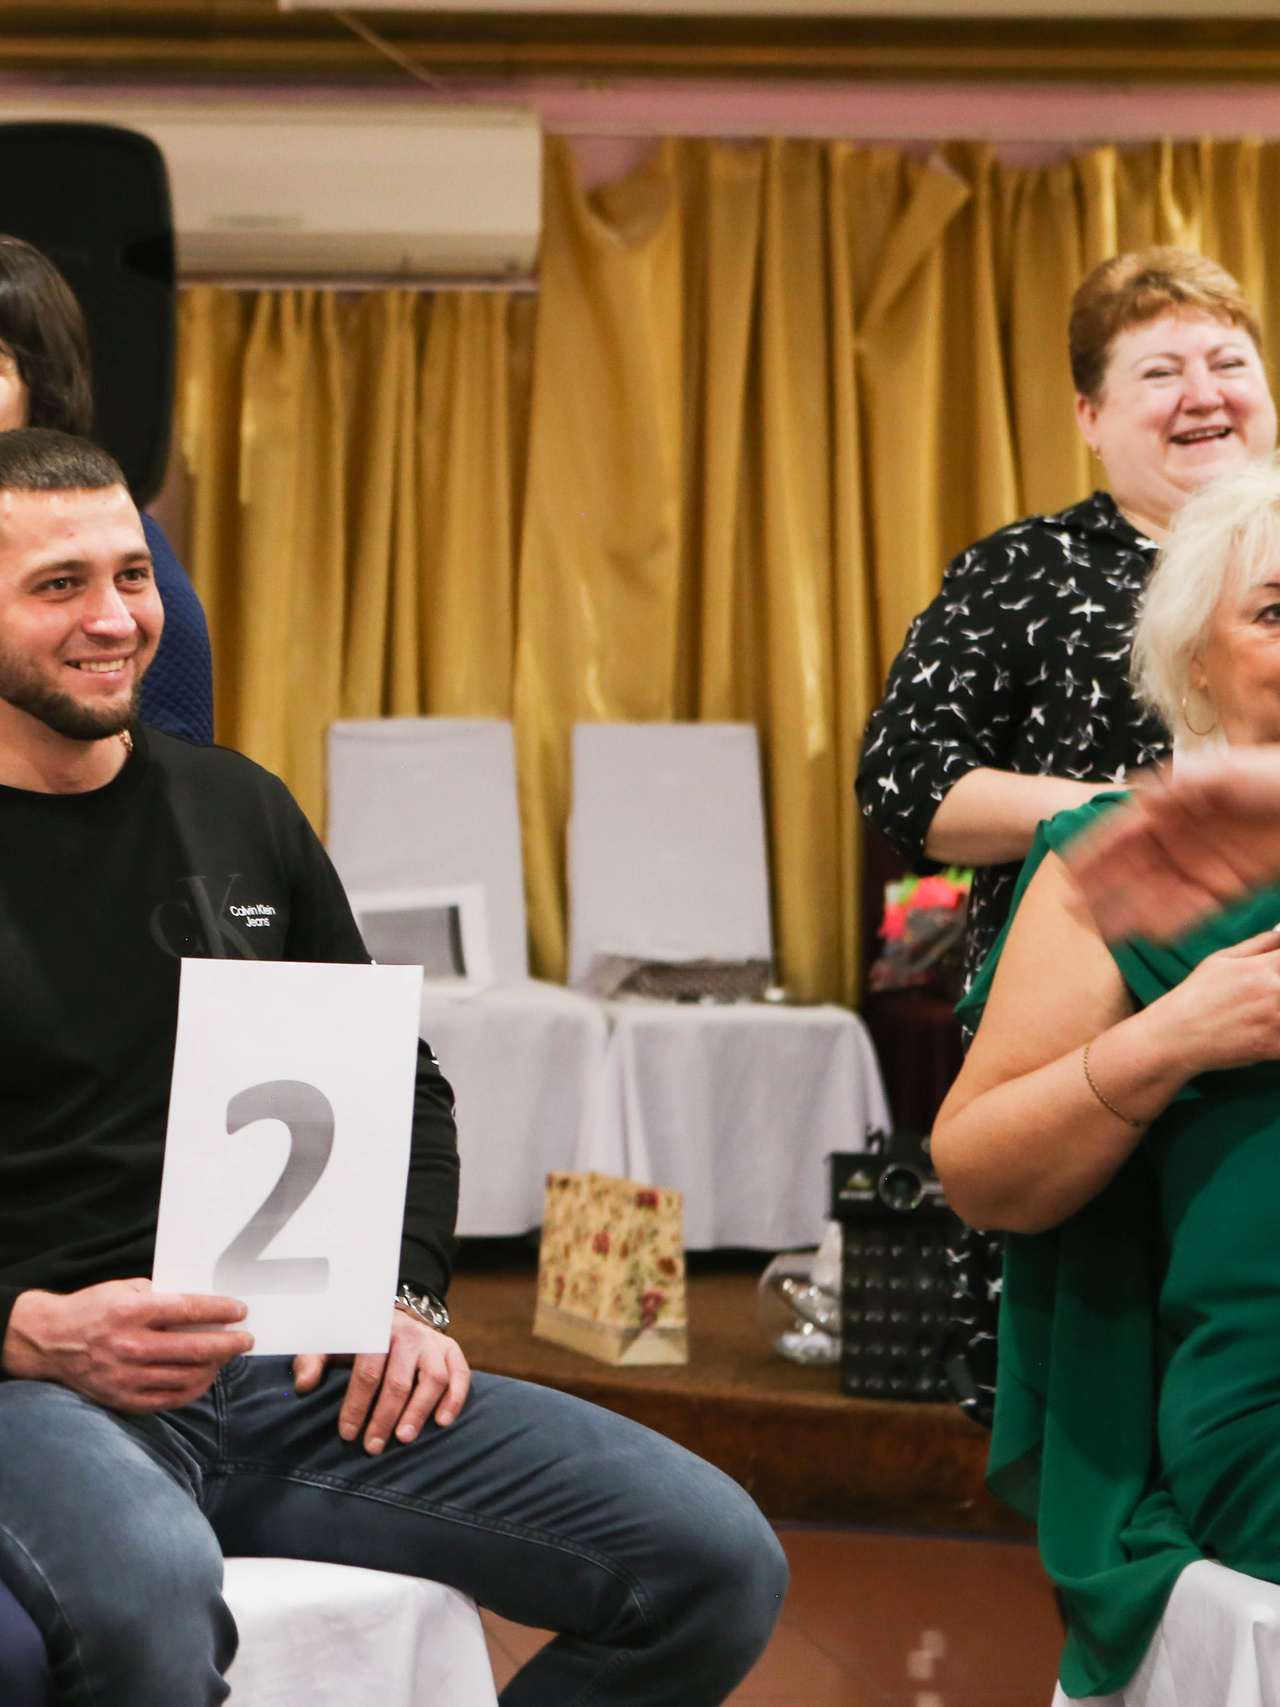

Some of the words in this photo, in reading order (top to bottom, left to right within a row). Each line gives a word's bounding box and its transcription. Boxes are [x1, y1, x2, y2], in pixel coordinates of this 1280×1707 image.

[229, 904, 258, 917] Calvin
[256, 904, 276, 916] Klein
[245, 916, 271, 928] Jeans
[212, 1079, 335, 1296] 2
